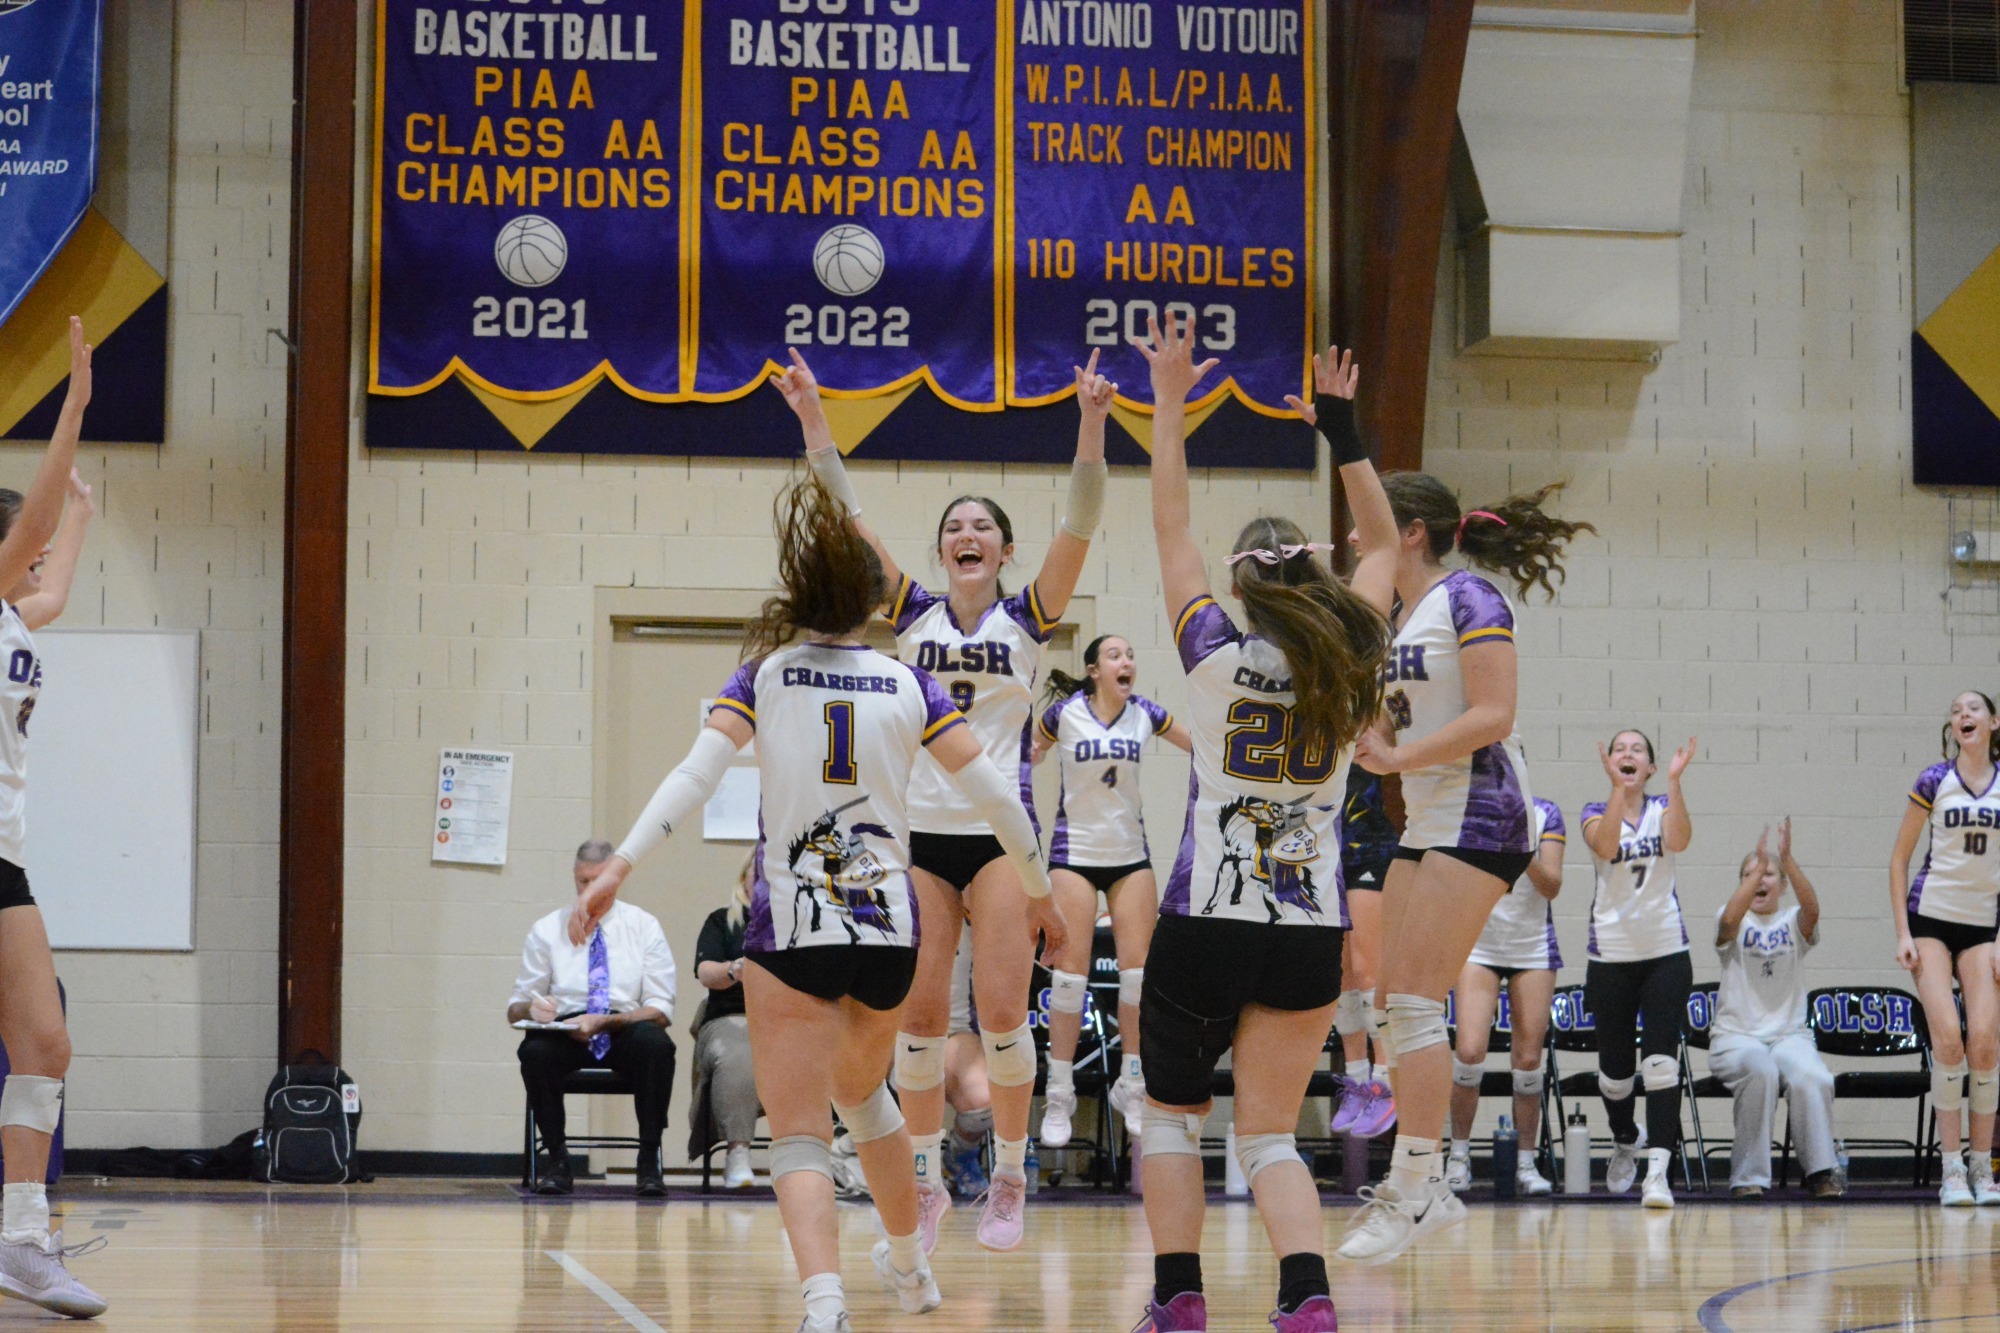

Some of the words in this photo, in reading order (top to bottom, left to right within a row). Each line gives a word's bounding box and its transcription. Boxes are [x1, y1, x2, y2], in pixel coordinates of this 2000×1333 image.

[414, 8, 658, 61] BASKETBALL
[730, 18, 970, 72] BASKETBALL
[1021, 0, 1152, 49] ANTONIO
[1176, 5, 1298, 55] VOTOUR
[475, 66, 595, 109] PIAA
[791, 76, 910, 120] PIAA
[0, 104, 29, 126] ol
[405, 113, 565, 158] CLASS
[603, 119, 664, 159] AA
[0, 159, 69, 175] AWARD
[723, 122, 880, 168] CLASS
[919, 129, 977, 170] AA
[1027, 122, 1124, 164] TRACK
[1147, 126, 1292, 171] CHAMPION
[397, 161, 671, 208] CHAMPIONS
[715, 169, 985, 218] CHAMPIONS
[1125, 184, 1195, 225] AA
[1027, 238, 1076, 279] 110
[1105, 241, 1294, 288] HURDLES
[473, 296, 588, 339] 2021
[785, 304, 910, 347] 2022
[917, 640, 1013, 676] OLSH
[783, 667, 898, 695] CHARGERS
[950, 680, 975, 714] 9
[444, 751, 452, 759] IN
[453, 752, 463, 760] AN
[465, 752, 510, 764] EMERGENCY
[823, 700, 857, 785] 1
[1075, 738, 1141, 763] OLSH
[1101, 765, 1118, 789] 4
[1294, 829, 1313, 855] OLSH
[1963, 832, 1987, 856] 10
[1631, 864, 1647, 889] 7
[1814, 993, 1914, 1035] OLSH
